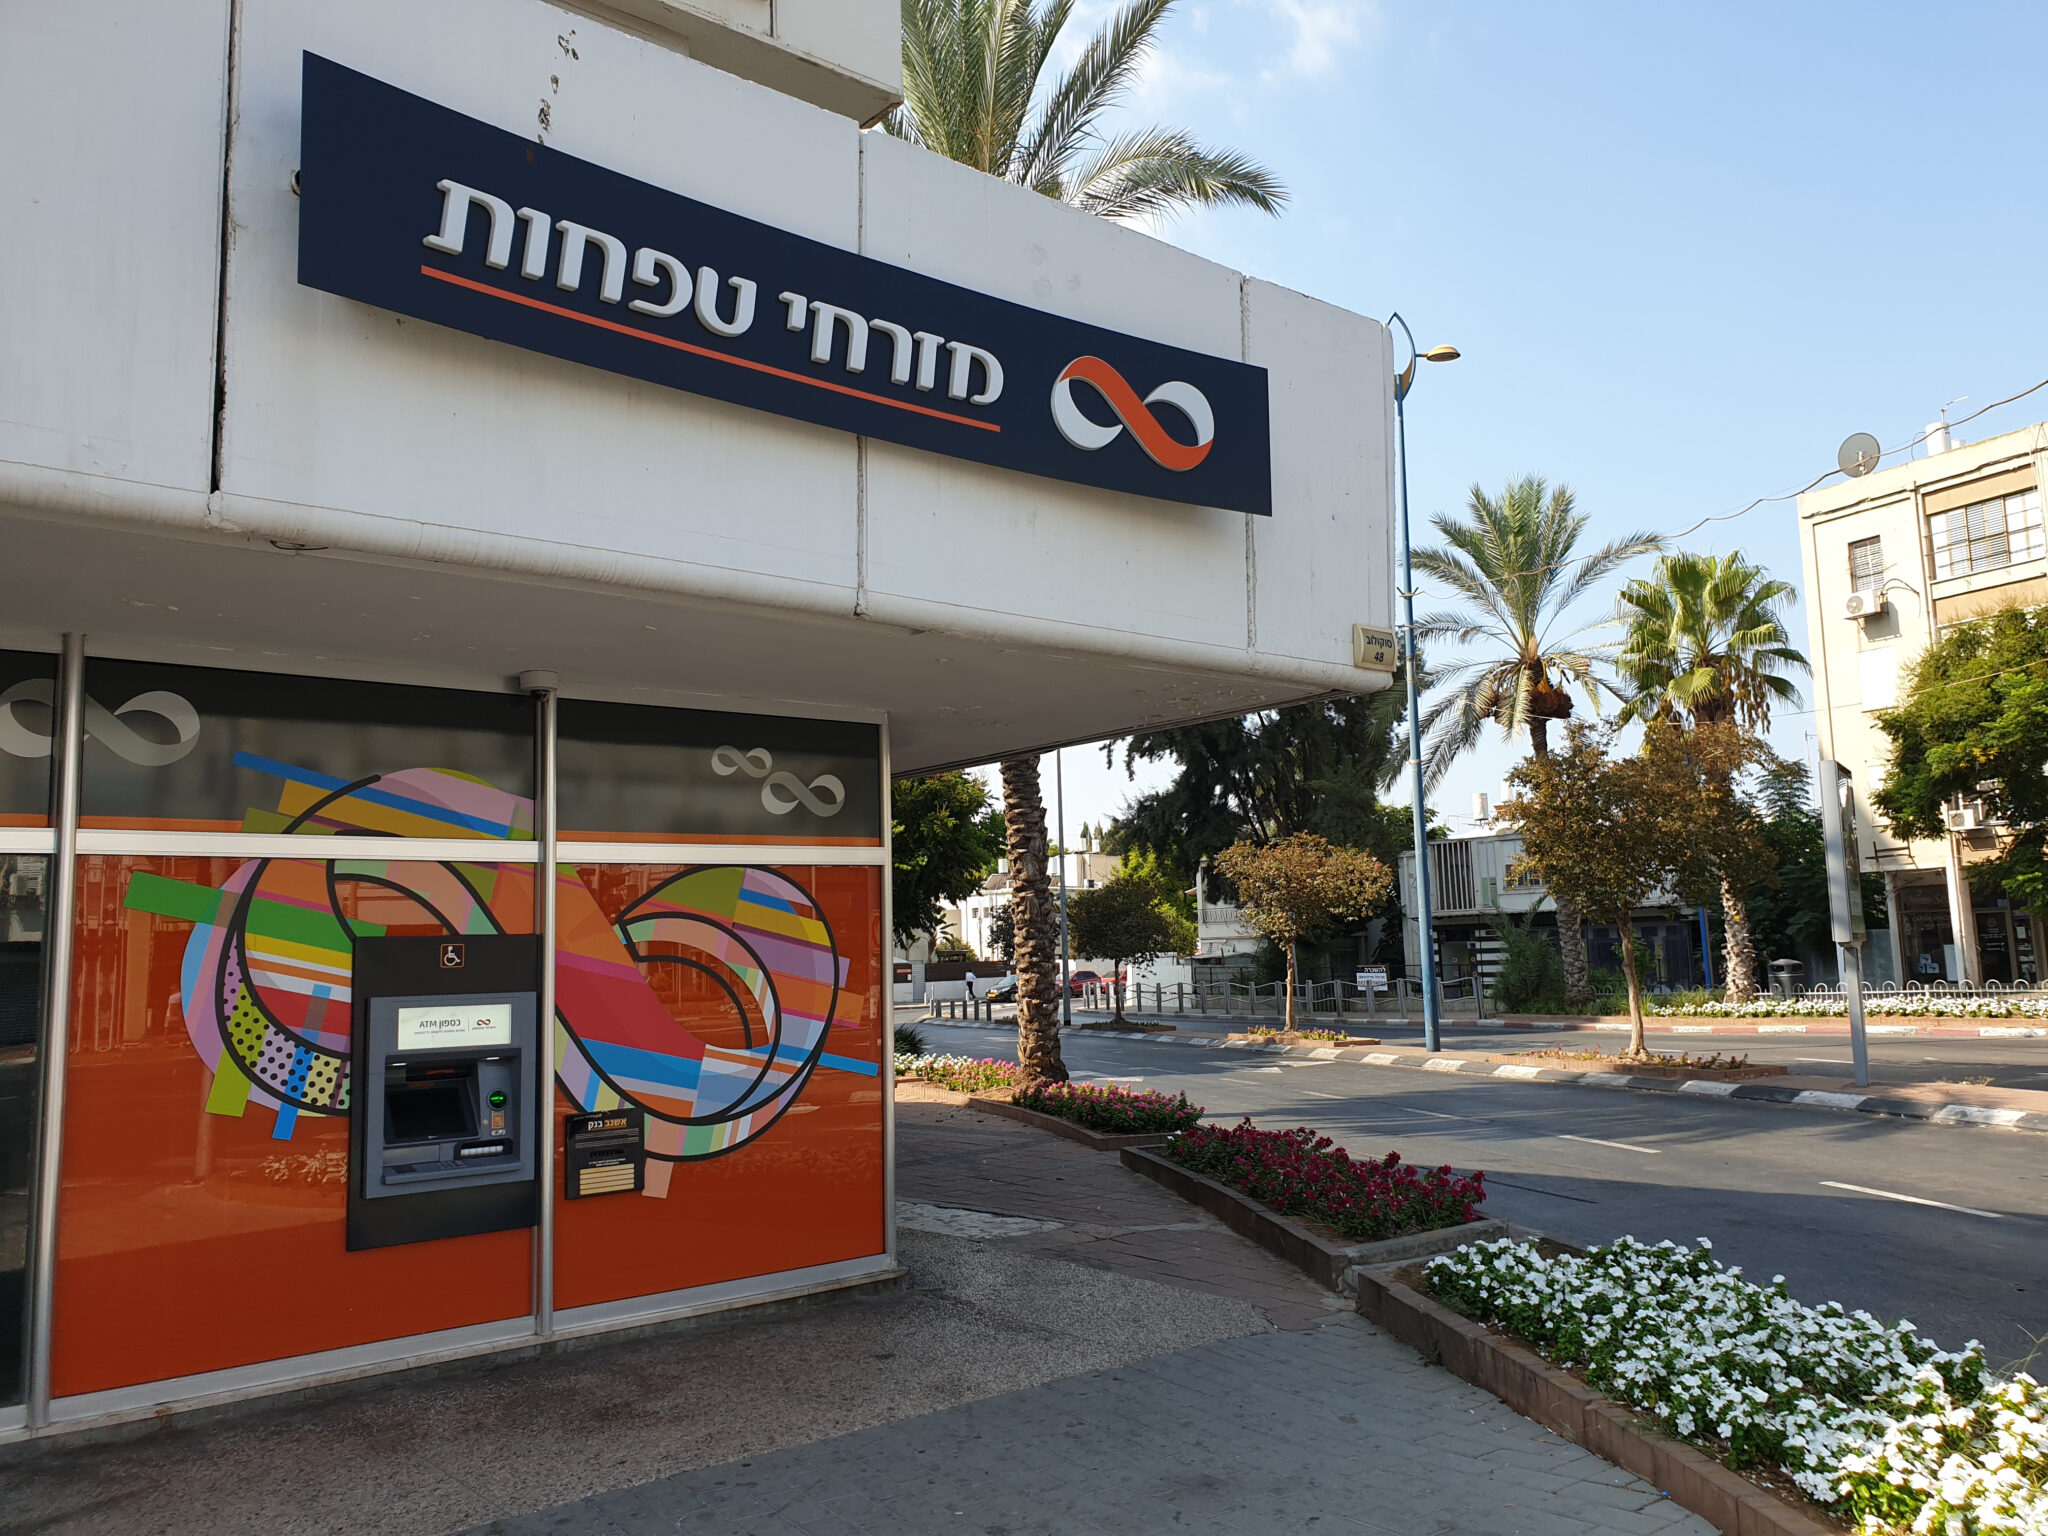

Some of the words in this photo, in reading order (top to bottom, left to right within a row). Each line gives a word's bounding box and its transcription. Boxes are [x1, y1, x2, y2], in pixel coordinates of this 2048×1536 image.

[422, 178, 758, 338] טפחות
[779, 291, 1004, 406] מזרחי
[1366, 635, 1393, 649] סוקולוב
[1374, 652, 1385, 662] 48
[419, 1020, 437, 1028] ATM
[439, 1019, 461, 1029] כספון
[588, 1120, 603, 1131] בנק
[604, 1118, 627, 1127] אשנב
